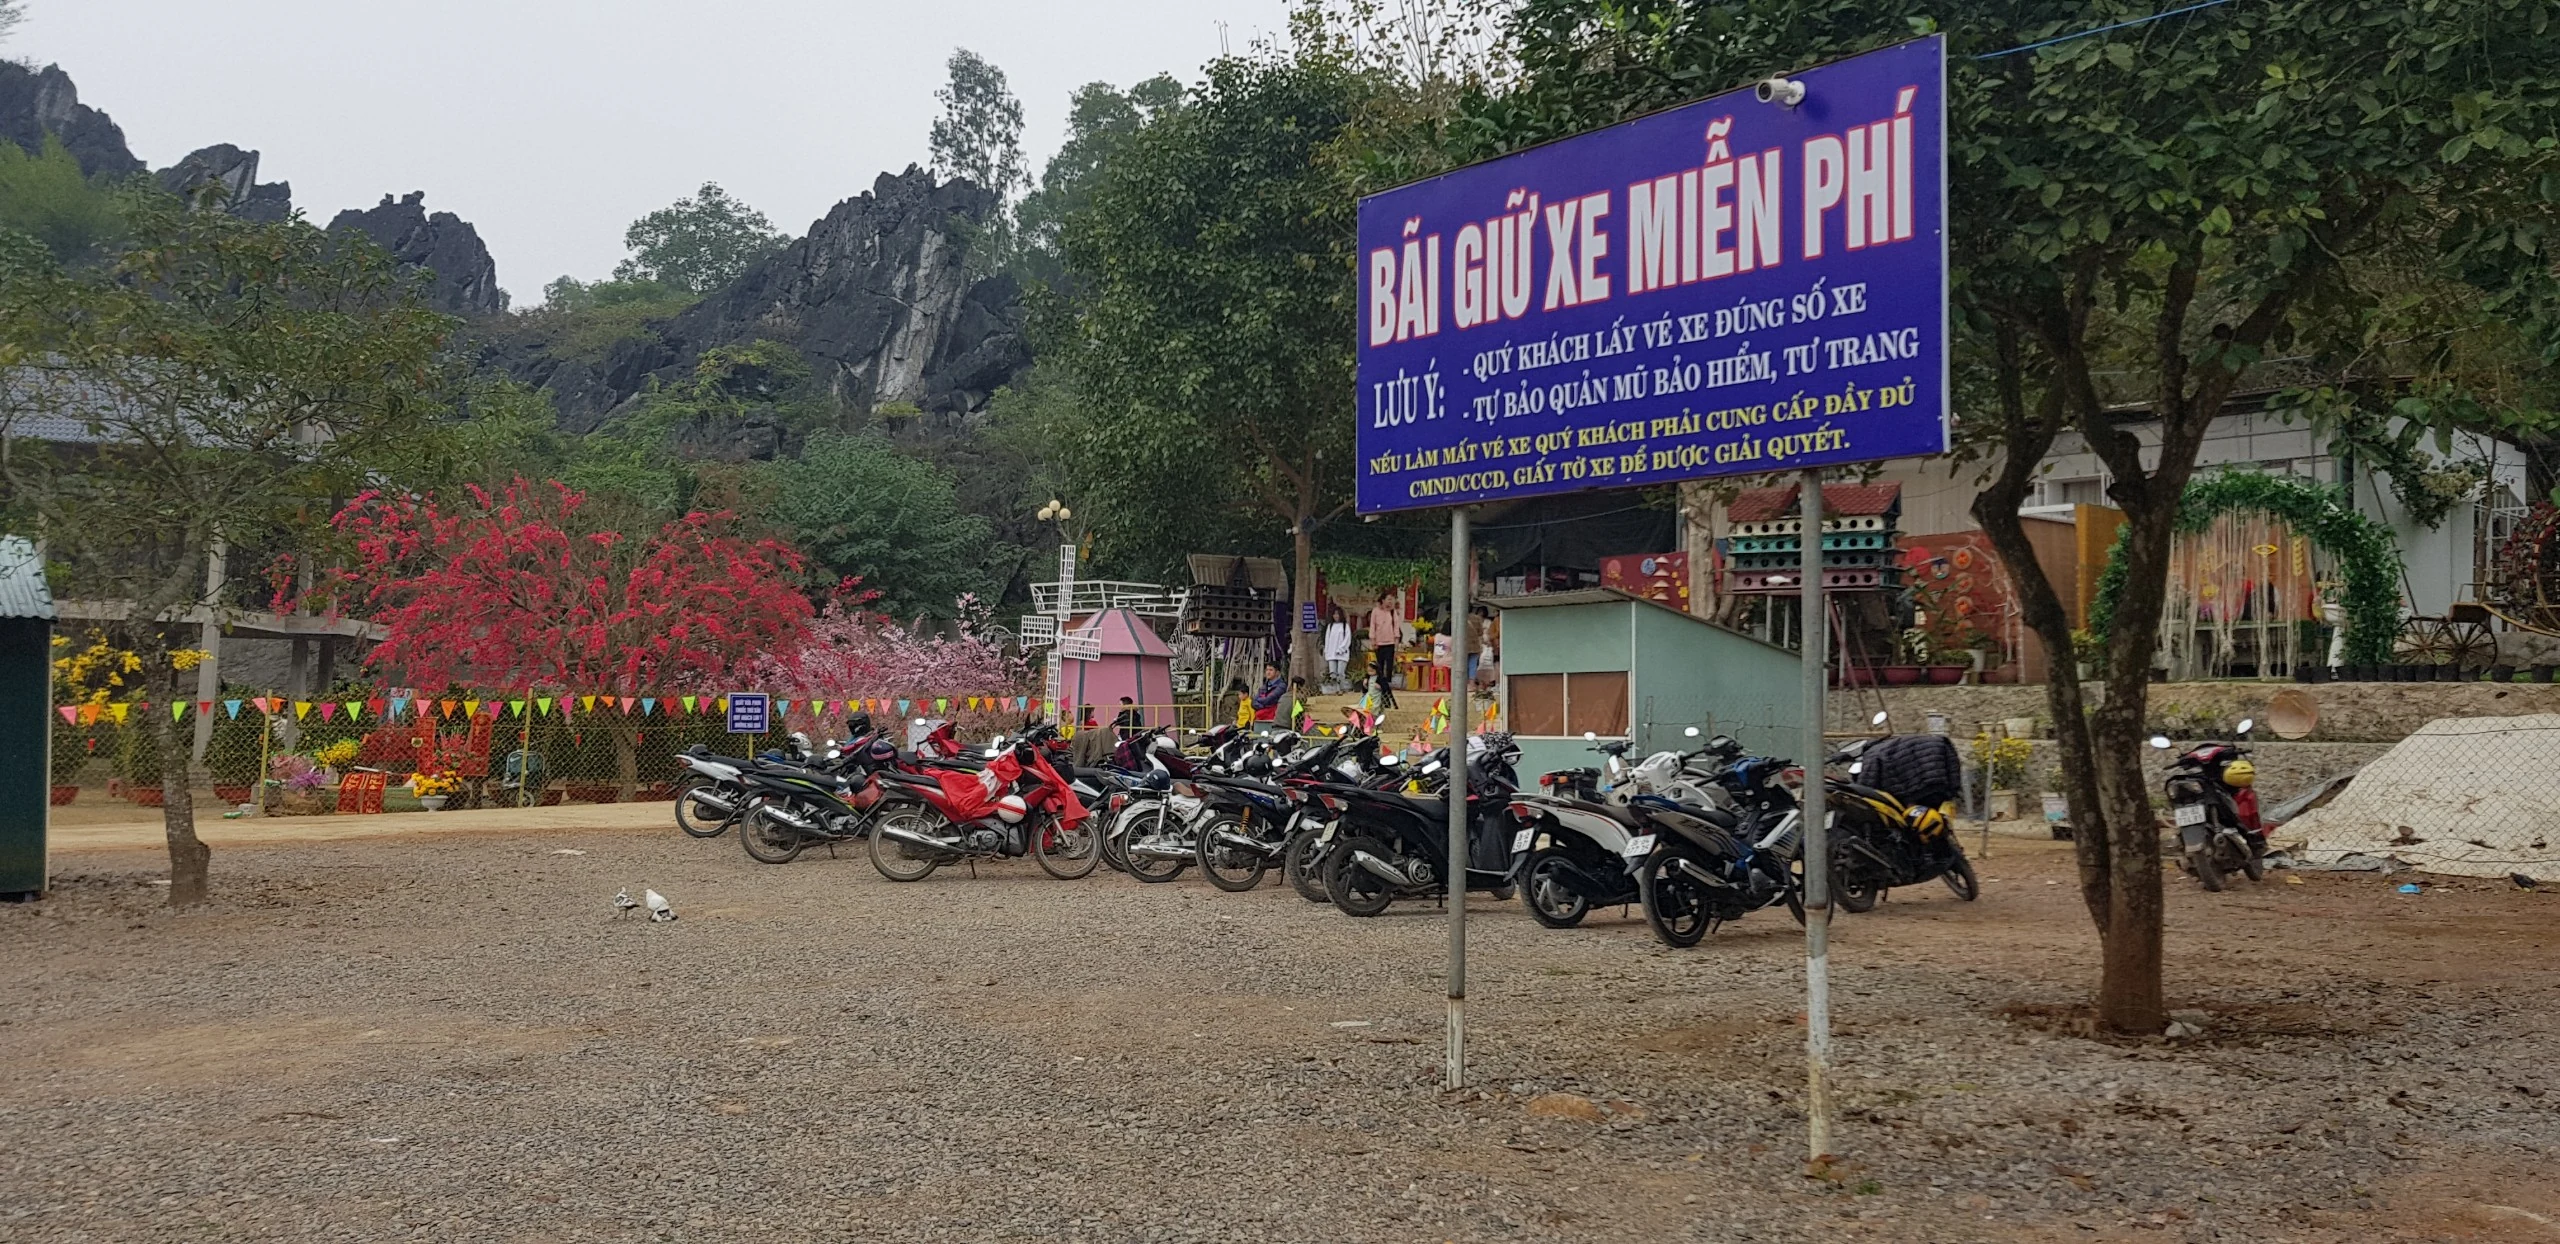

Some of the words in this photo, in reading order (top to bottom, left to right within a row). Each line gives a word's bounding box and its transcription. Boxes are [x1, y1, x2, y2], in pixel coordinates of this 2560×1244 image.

[1371, 215, 1440, 347] BÃI
[1454, 186, 1540, 330] GIỮ
[1542, 189, 1611, 312] XE
[1627, 114, 1783, 295] MIỄN
[1803, 85, 1919, 261] PHÍ
[1473, 340, 1513, 383] QUÝ
[1518, 331, 1590, 371] KHÁCH
[1595, 315, 1637, 357] LẤY
[1642, 311, 1673, 349] VÉ
[1677, 312, 1709, 343] XE
[1715, 297, 1785, 337] ĐÚNG
[1792, 276, 1826, 324] SỐ
[1831, 282, 1867, 317] XE
[1473, 389, 1500, 426] TỰ
[1504, 379, 1545, 418] BẢO
[1549, 369, 1609, 415] QUẢN
[1613, 364, 1648, 402] MŨ
[1653, 355, 1701, 396] BẢO
[1706, 340, 1777, 389] HIỂM,
[1783, 336, 1820, 375] TƯ
[1825, 327, 1920, 369] TRANG
[1370, 449, 1401, 475] NẾU
[1405, 447, 1438, 471] LÀM
[1442, 437, 1478, 465] MẤT
[1482, 435, 1504, 459] VÉ
[1508, 436, 1531, 456] XE
[1535, 426, 1573, 456] QUÝ
[1578, 419, 1645, 447] KHÁCH
[1650, 407, 1701, 438] PHẢI
[1706, 404, 1767, 432] CUNG
[1772, 390, 1819, 422] CẤP
[1824, 381, 1874, 416] ĐẦY
[1879, 376, 1916, 408] ĐỦ
[1374, 368, 1419, 428] LƯU
[1424, 357, 1445, 419] Ý:
[1409, 470, 1509, 498] CMND/CCCD,
[1513, 457, 1557, 485] GIẤY
[1561, 455, 1587, 480] TỜ
[1590, 457, 1615, 477] XE
[1619, 444, 1648, 474] ĐỂ
[1652, 443, 1710, 471] ĐƯỢC
[1714, 434, 1762, 464] GIẢI
[1767, 421, 1851, 460] QUYẾT.
